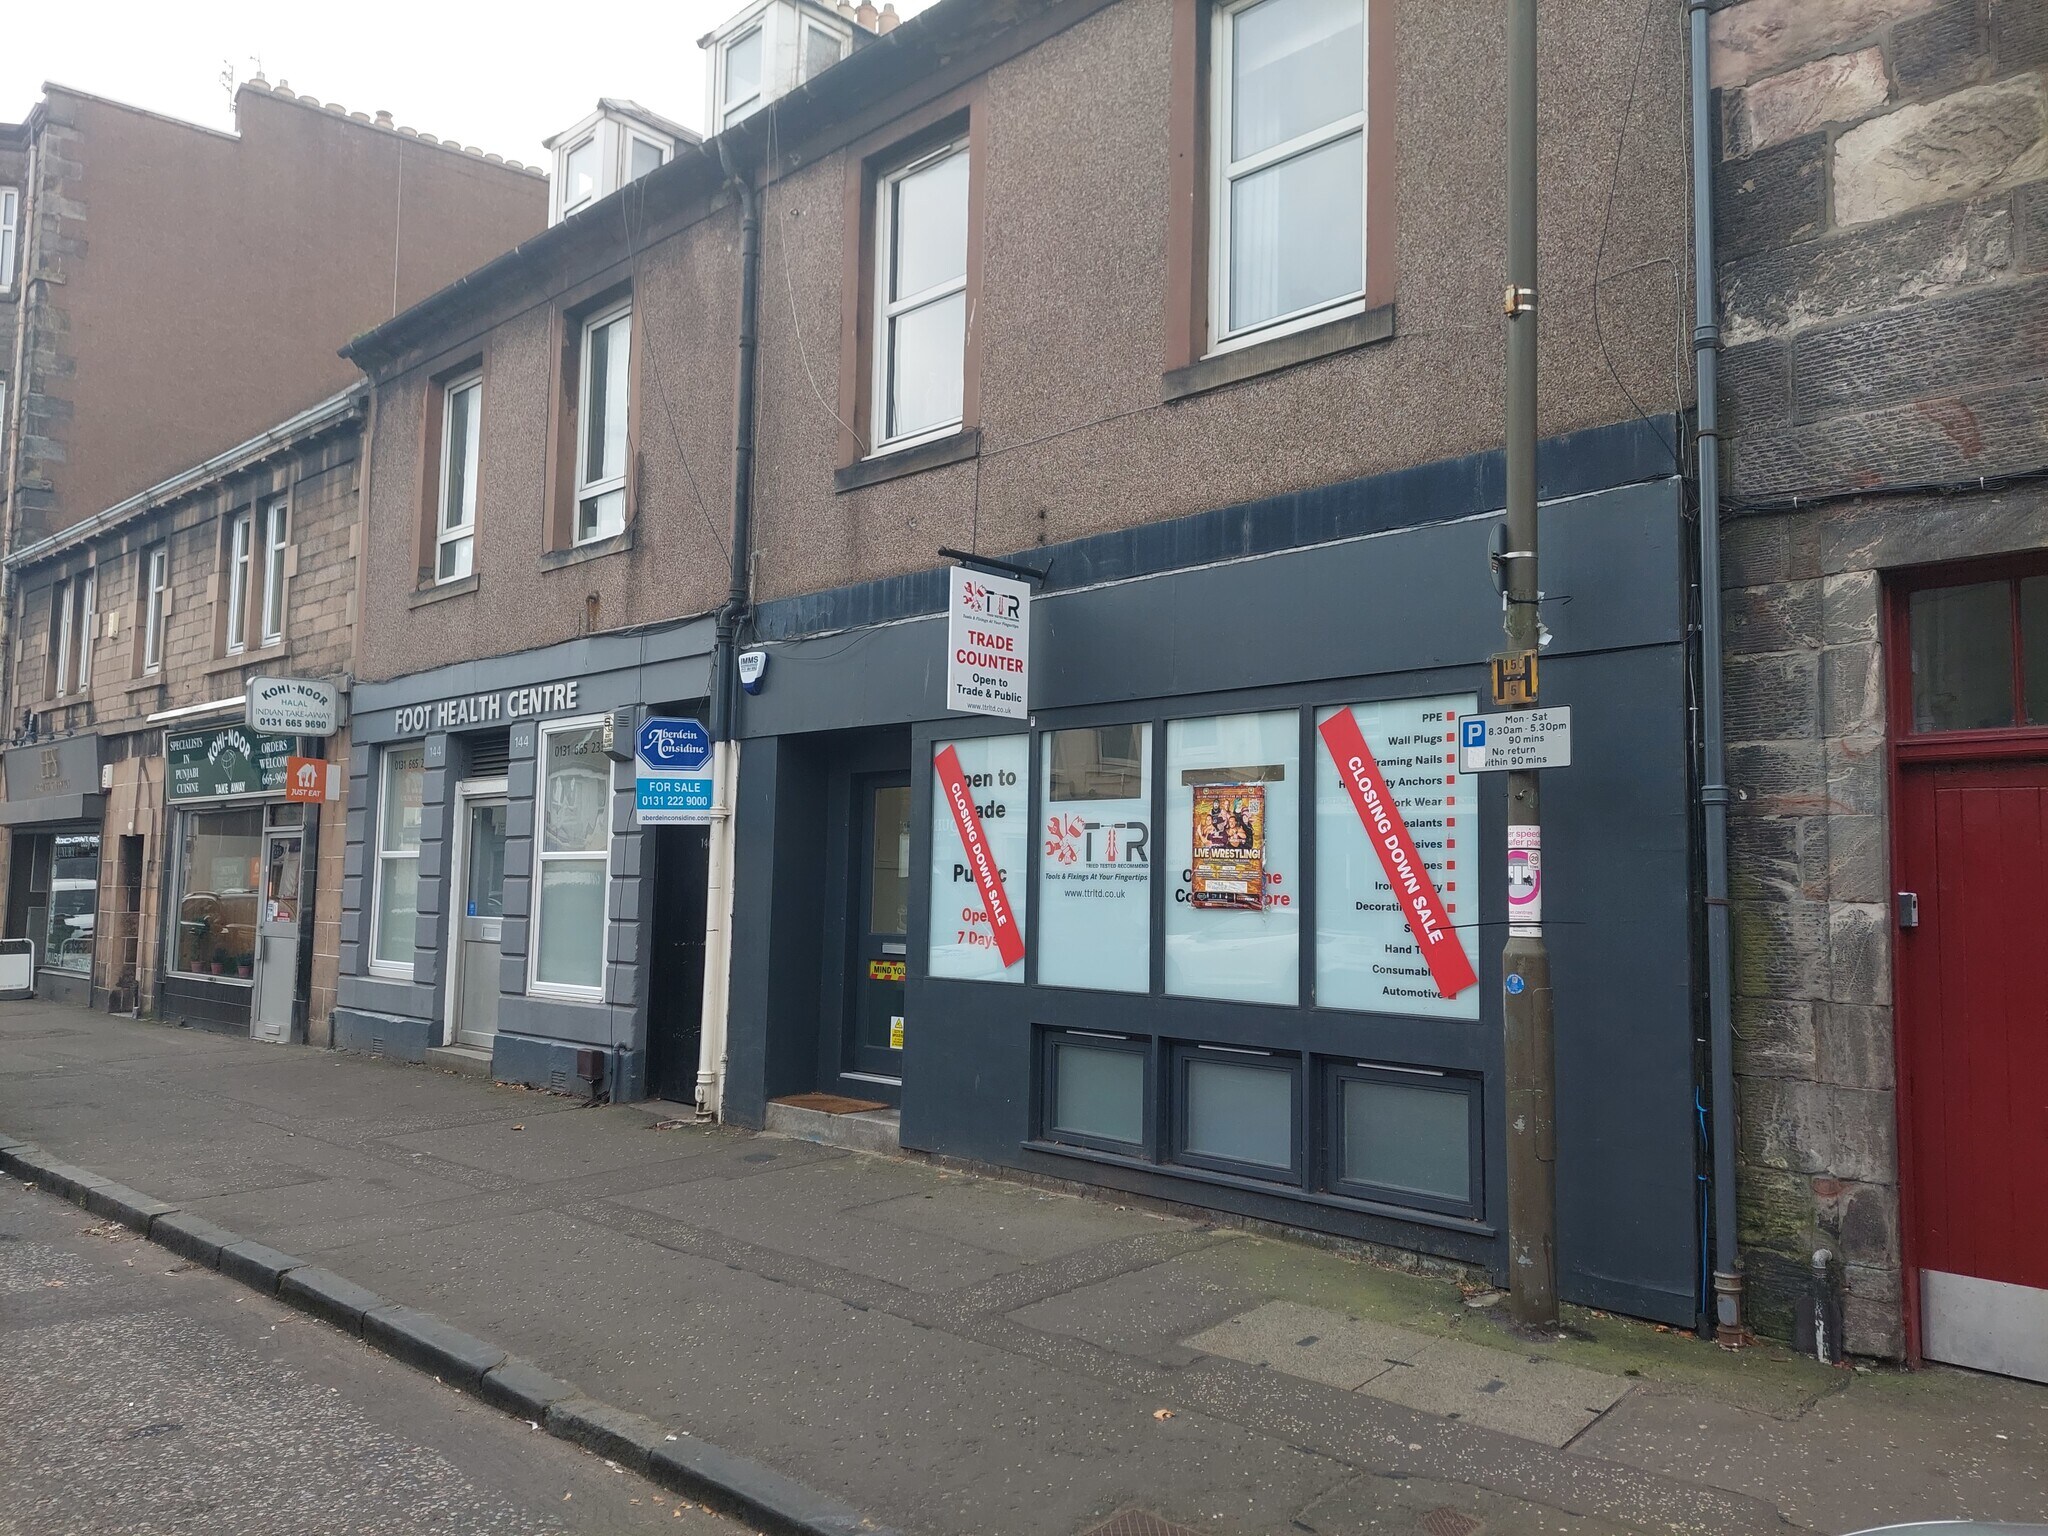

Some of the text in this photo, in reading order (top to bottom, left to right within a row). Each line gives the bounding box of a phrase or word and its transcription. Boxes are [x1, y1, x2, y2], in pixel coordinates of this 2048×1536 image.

[968, 630, 1013, 652] TRADE
[956, 649, 1024, 673] COUNTER
[1504, 658, 1524, 671] 150
[972, 672, 1008, 687] Open to
[261, 684, 328, 706] KOHI-NOOR
[956, 683, 1022, 703] Trade & Public
[1510, 685, 1517, 696] 5
[281, 699, 308, 708] HALAL
[394, 681, 578, 734] FOOT HEALTH CENTRE
[255, 708, 284, 716] INDIAN
[1422, 712, 1443, 722] PPE
[1505, 715, 1524, 724] Mon
[1532, 712, 1548, 722] Sat
[259, 718, 327, 729] 0131 665 9690
[1488, 727, 1523, 736] 8.30am
[1530, 722, 1567, 732] 5.30pm
[643, 728, 698, 750] Aberdein
[1388, 733, 1443, 746] Wall Plugs
[1468, 724, 1482, 745] P
[1508, 734, 1545, 745] 90 mins
[169, 737, 203, 752] SPECIALISTS
[207, 729, 251, 766] KOHI-NOOR
[261, 740, 288, 753] ORDERS
[514, 735, 529, 748] 144
[429, 745, 442, 757] 144
[554, 745, 571, 757] 0131
[574, 743, 588, 756] 665
[658, 738, 705, 759] Considine
[1492, 746, 1536, 756] No return
[183, 754, 190, 764] IN
[259, 756, 289, 769] WELCOM
[394, 758, 407, 771] 0131
[408, 757, 419, 769] 665
[1416, 754, 1443, 764] Nails
[1511, 756, 1524, 765] 90
[1526, 755, 1547, 765] mins
[175, 767, 199, 781] PUNJABI
[963, 769, 1017, 788] pen to
[215, 781, 246, 794] TAKE AWAY
[649, 782, 701, 793] FOR SALE
[1398, 776, 1443, 787] Anchors
[176, 783, 200, 794] CUISINE
[291, 788, 321, 797] JUST EAT
[642, 796, 708, 806] 0131 222 9000
[1393, 796, 1443, 808] ork Wear
[975, 800, 1006, 818] ade
[1404, 818, 1443, 828] ealants
[1084, 822, 1149, 862] TTR
[951, 782, 1007, 927] CLOSING DOWN SALE
[1194, 848, 1261, 859] LIVE WRESTLING!
[1348, 756, 1392, 834] CLOSING
[1384, 834, 1421, 895] DOWN
[1412, 895, 1444, 945] SALE
[1067, 873, 1089, 881] Fixings
[1098, 873, 1114, 881] Your
[1114, 874, 1148, 882] Fingertips
[1064, 889, 1126, 899] www.ttrltd.co.uk
[1355, 901, 1404, 912] Decorati
[962, 907, 990, 925] Ope
[957, 931, 965, 945] 7
[1385, 944, 1412, 955] Hand
[873, 966, 891, 974] MIND
[1372, 964, 1433, 977] Consumabl
